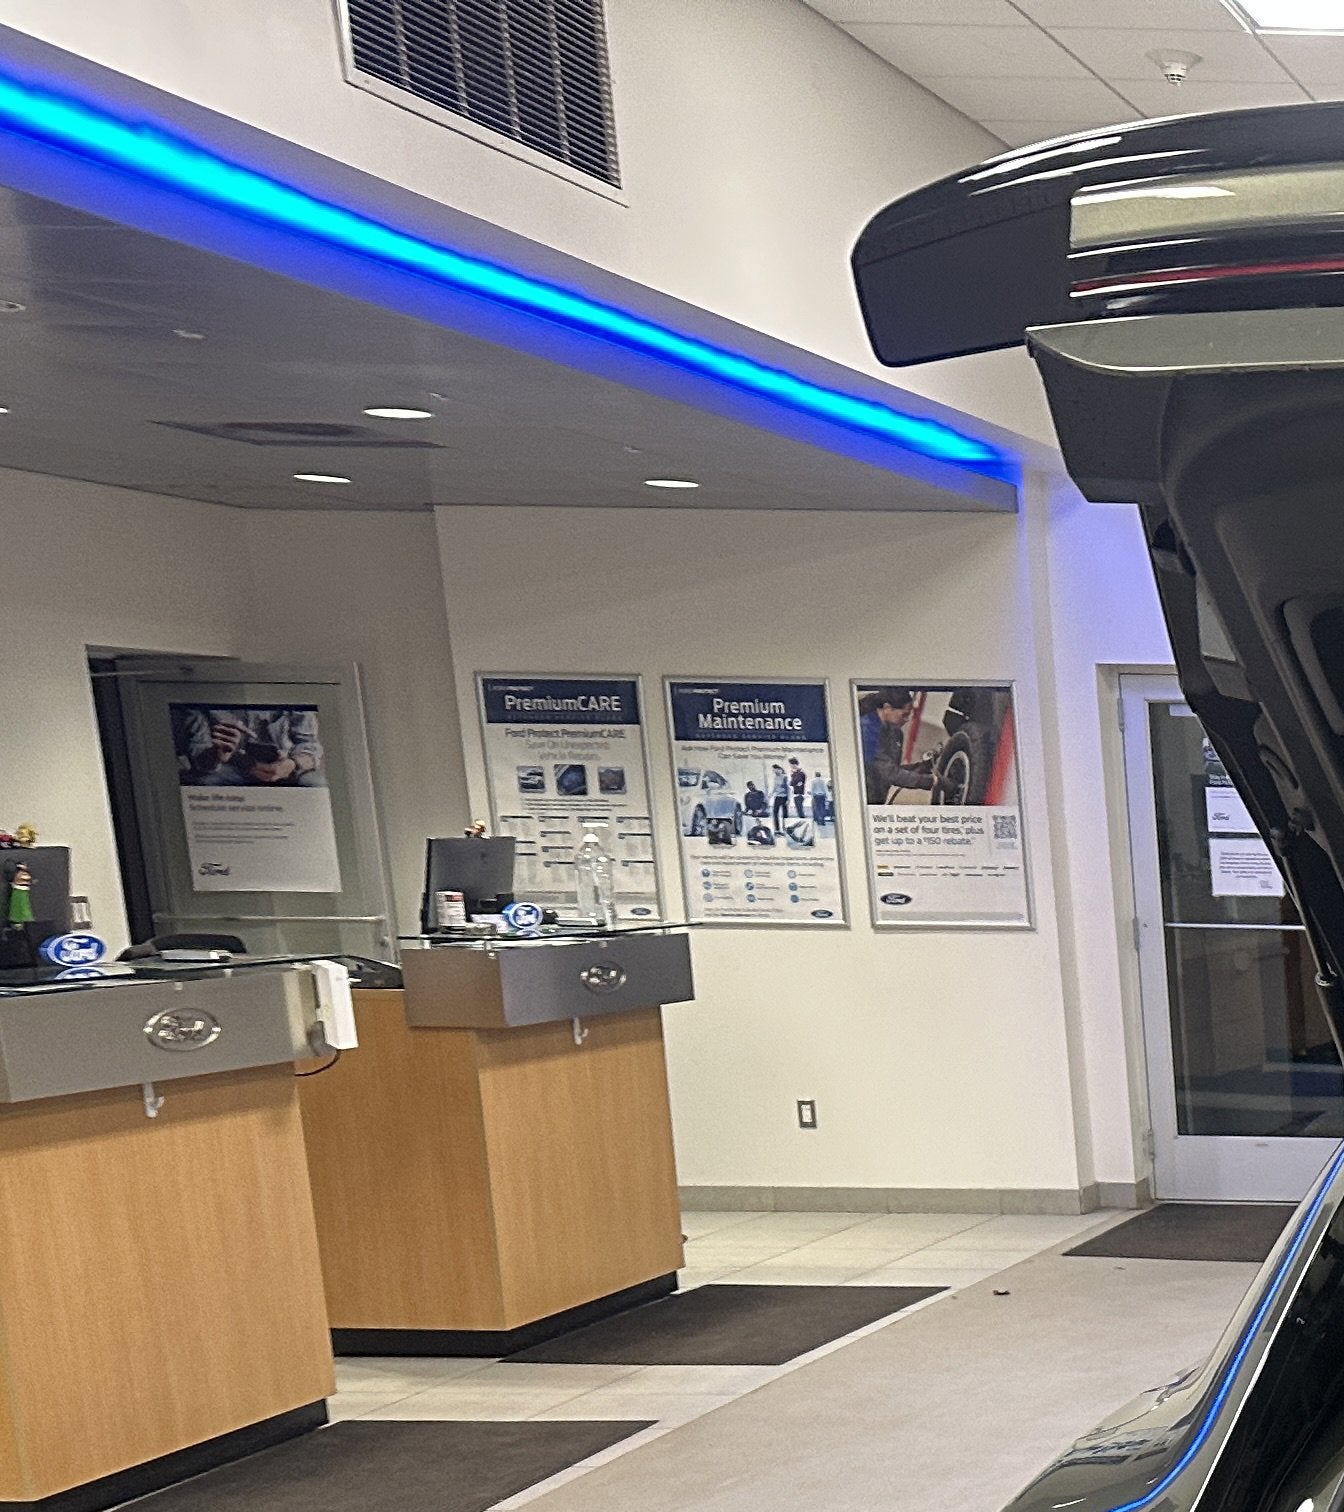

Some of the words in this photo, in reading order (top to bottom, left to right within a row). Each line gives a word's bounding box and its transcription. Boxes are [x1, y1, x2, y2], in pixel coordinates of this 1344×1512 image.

[503, 694, 622, 711] PremiumCARE
[712, 698, 785, 714] Premium
[698, 713, 802, 730] Maintenance
[918, 815, 938, 825] your
[940, 814, 960, 824] best
[960, 815, 983, 825] price
[894, 826, 909, 834] set
[910, 825, 920, 834] of
[921, 825, 940, 834] four
